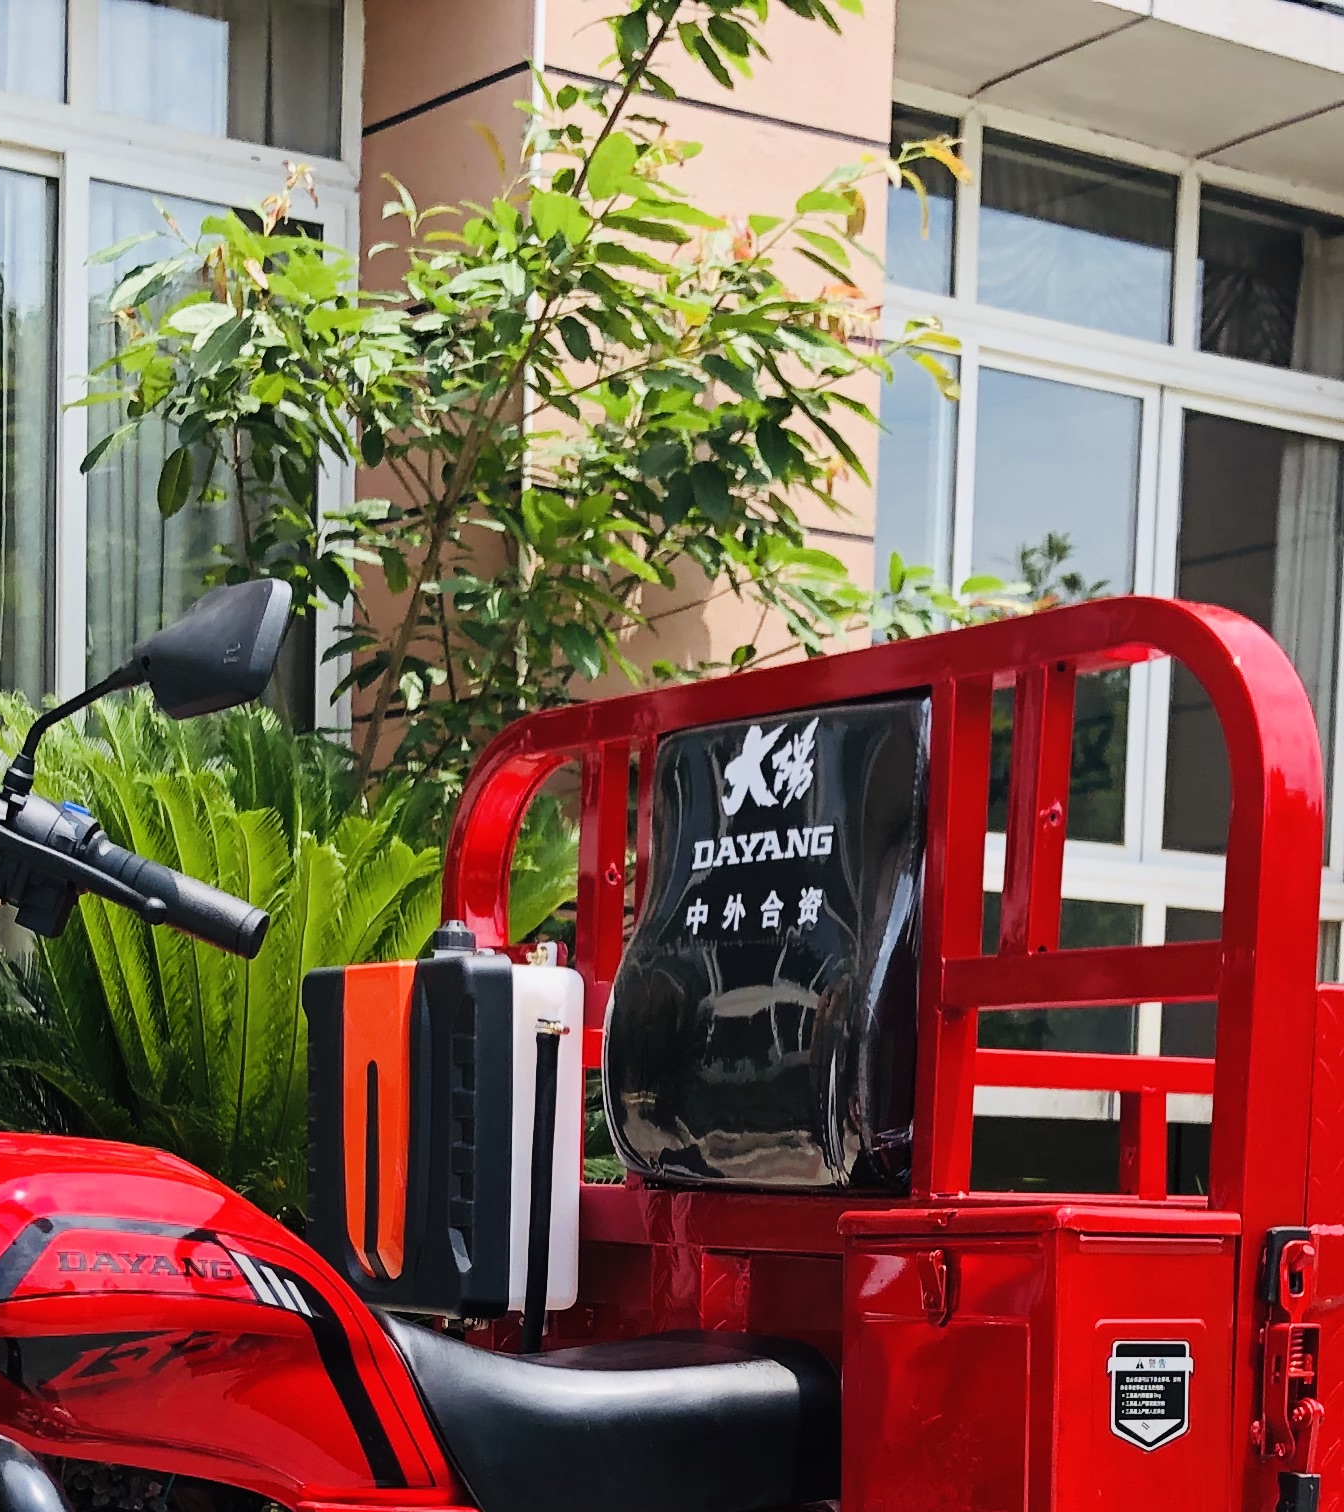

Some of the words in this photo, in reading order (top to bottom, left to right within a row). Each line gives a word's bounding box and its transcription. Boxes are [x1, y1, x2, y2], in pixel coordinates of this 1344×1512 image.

[692, 824, 835, 870] DAYANG
[686, 886, 824, 935] 中外合资
[57, 1251, 235, 1281] DAYANG
